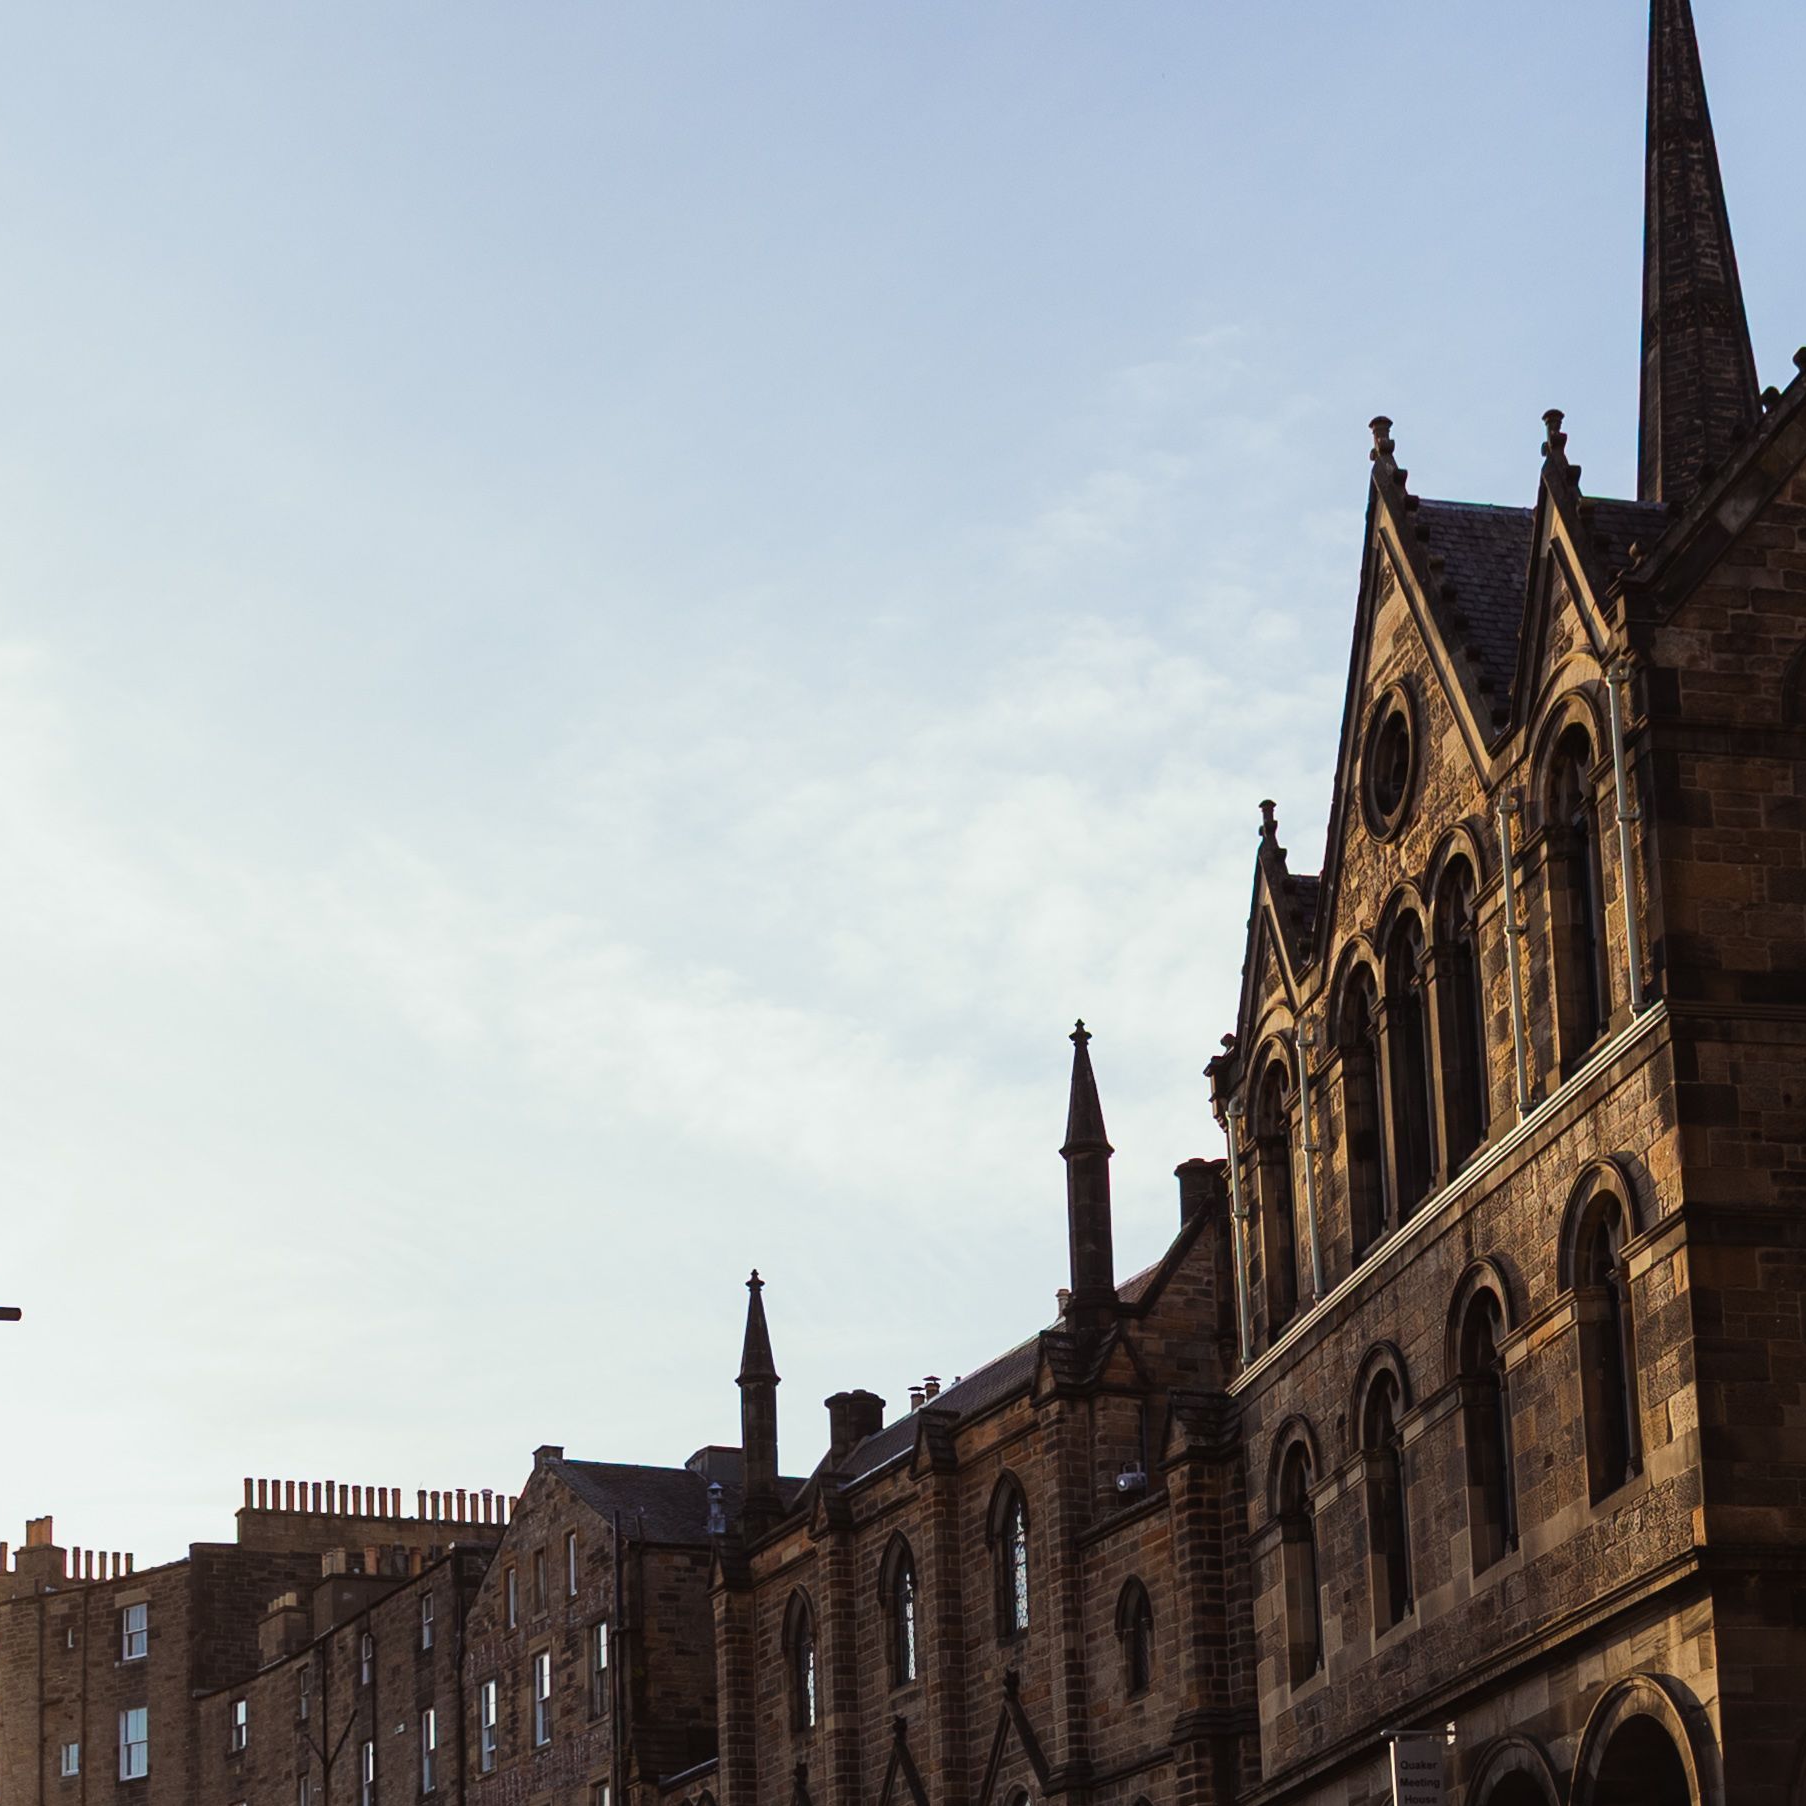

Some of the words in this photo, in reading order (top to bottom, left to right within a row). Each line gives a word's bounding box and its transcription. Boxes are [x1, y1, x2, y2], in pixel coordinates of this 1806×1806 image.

[1400, 1760, 1438, 1770] Quaker
[1400, 1778, 1441, 1789] Meeting
[1404, 1795, 1438, 1804] House
